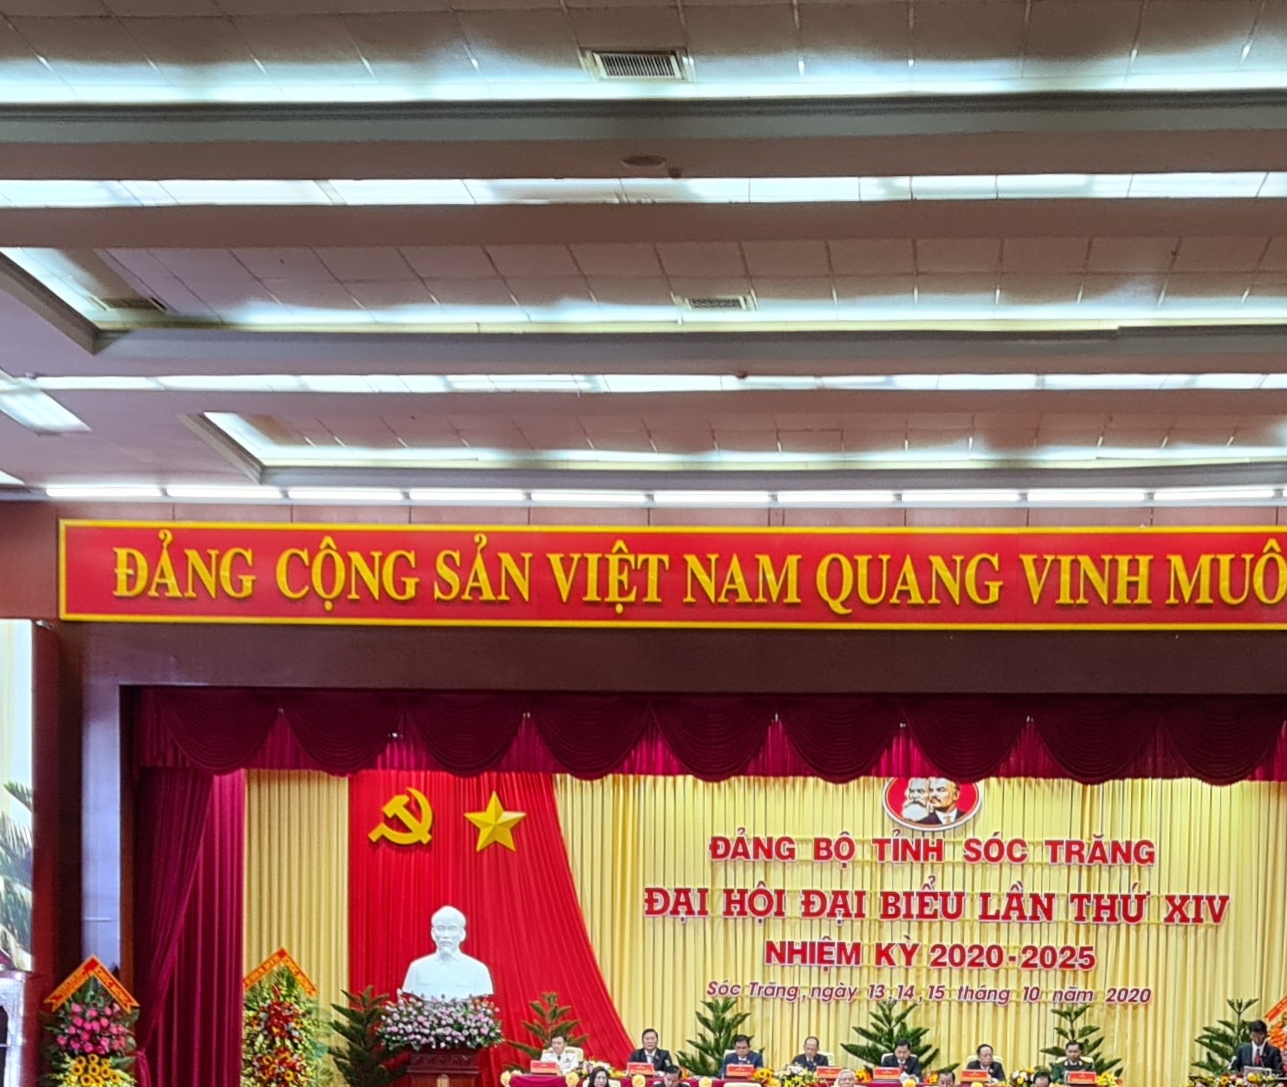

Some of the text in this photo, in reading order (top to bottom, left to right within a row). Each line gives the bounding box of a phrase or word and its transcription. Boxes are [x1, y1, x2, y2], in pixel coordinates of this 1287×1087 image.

[113, 528, 256, 600] ĐẢNG
[275, 536, 418, 611] CỘNG
[433, 534, 533, 603] SẢN
[549, 539, 669, 614] VIỆT
[683, 552, 802, 604] NAM
[816, 552, 1004, 616] QUANG
[1020, 553, 1152, 605] VINH
[709, 827, 1156, 868] ĐẢNG BỘ TỈNH SÓC TRĂNG
[644, 876, 1230, 925] ĐẠI HỘI ĐẠI BIỂU LẦN THỨ XIV
[765, 935, 862, 972] NHIỆM
[875, 934, 920, 967] KỲ
[707, 979, 740, 996] Sóc
[811, 983, 858, 1003] ngày
[928, 985, 946, 1000] 15
[957, 985, 1011, 1005] tháng
[1023, 986, 1041, 1002] 10
[1052, 986, 1094, 1003] năm
[1106, 987, 1151, 1004] 2020
